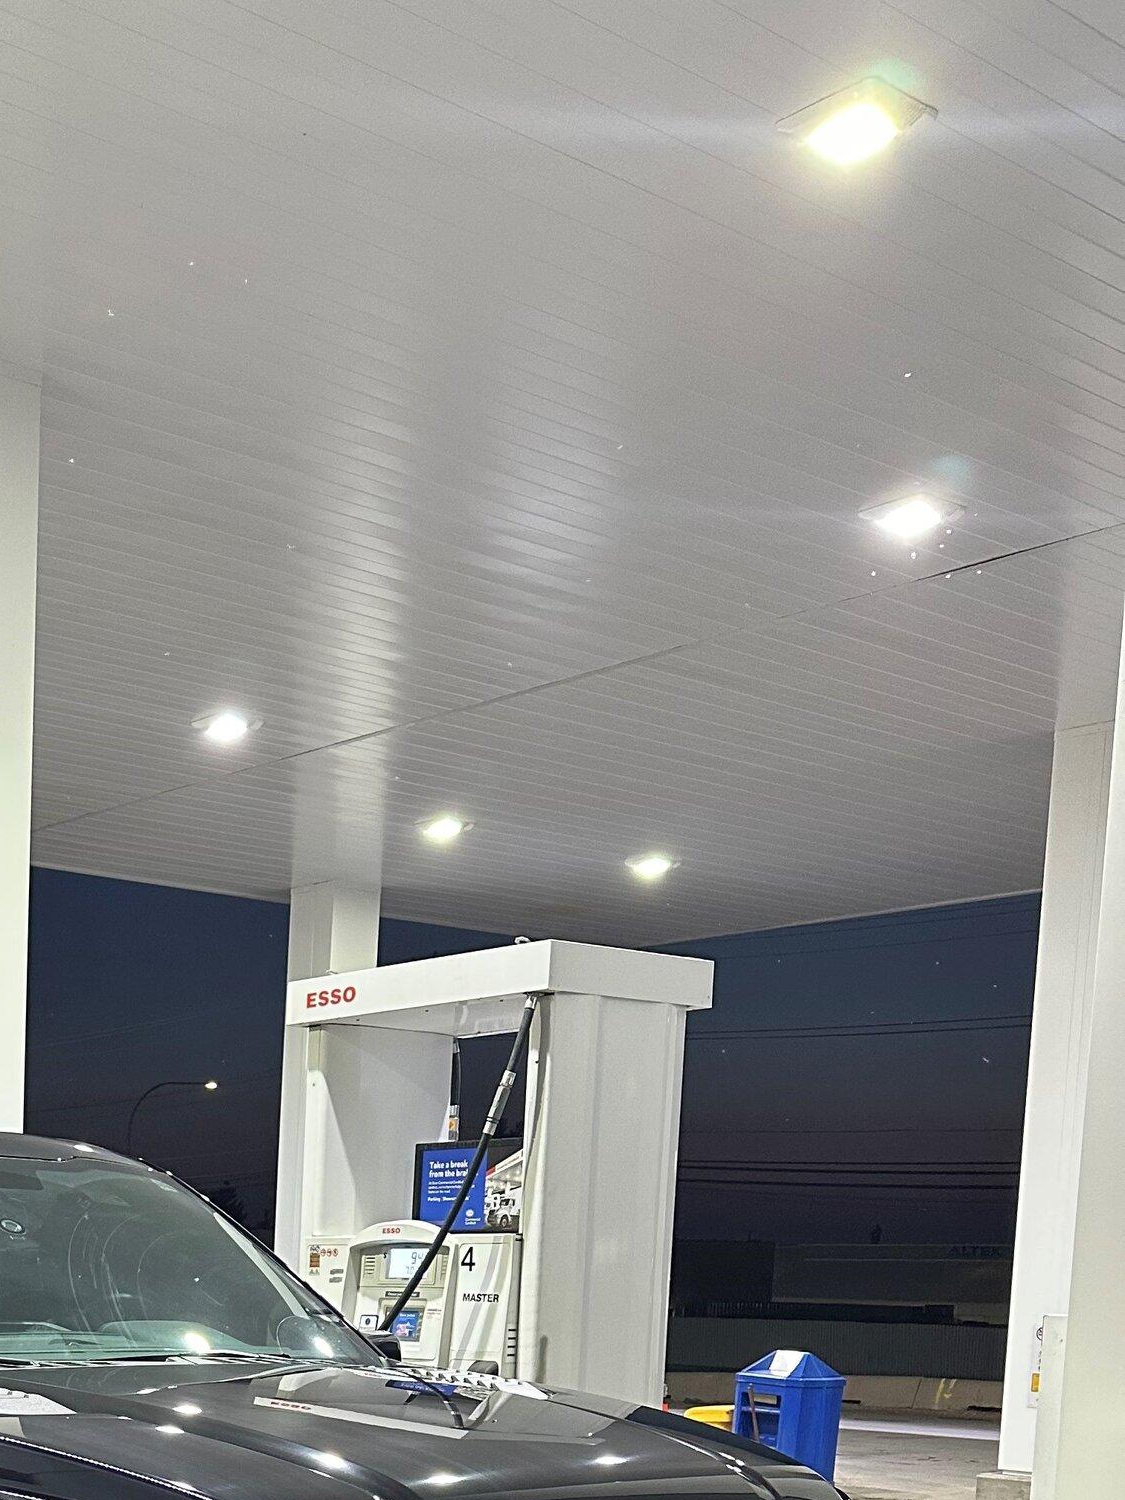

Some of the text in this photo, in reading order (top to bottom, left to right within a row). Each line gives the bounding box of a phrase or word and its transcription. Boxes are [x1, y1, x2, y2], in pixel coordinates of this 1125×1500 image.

[306, 986, 356, 1008] ESSO
[429, 1161, 445, 1169] Take
[450, 1159, 468, 1168] break
[429, 1170, 444, 1178] from
[444, 1169, 455, 1177] the
[461, 1246, 475, 1271] 4
[462, 1293, 500, 1303] MASTER
